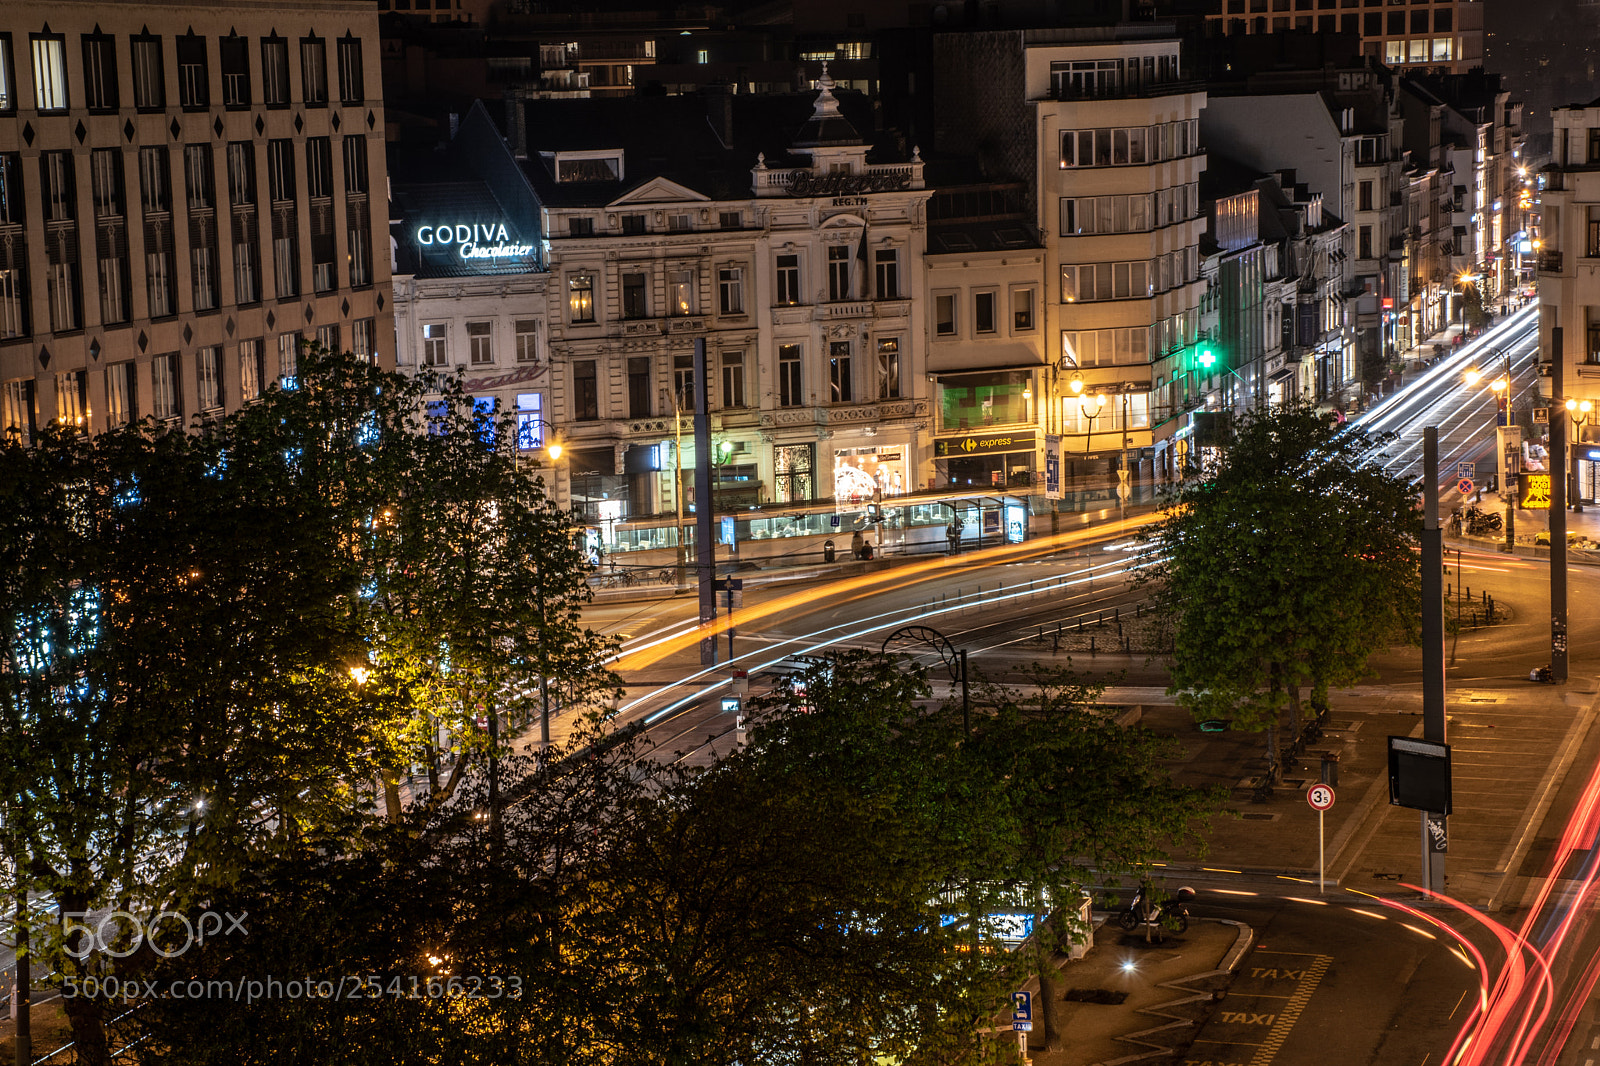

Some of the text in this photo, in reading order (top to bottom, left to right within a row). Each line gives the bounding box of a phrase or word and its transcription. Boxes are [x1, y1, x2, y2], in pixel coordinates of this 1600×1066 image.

[418, 224, 509, 245] GODIVA
[460, 241, 533, 258] Chocolatier
[980, 437, 1011, 448] express
[1251, 967, 1306, 980] TAXI
[1221, 1011, 1275, 1025] TAXI
